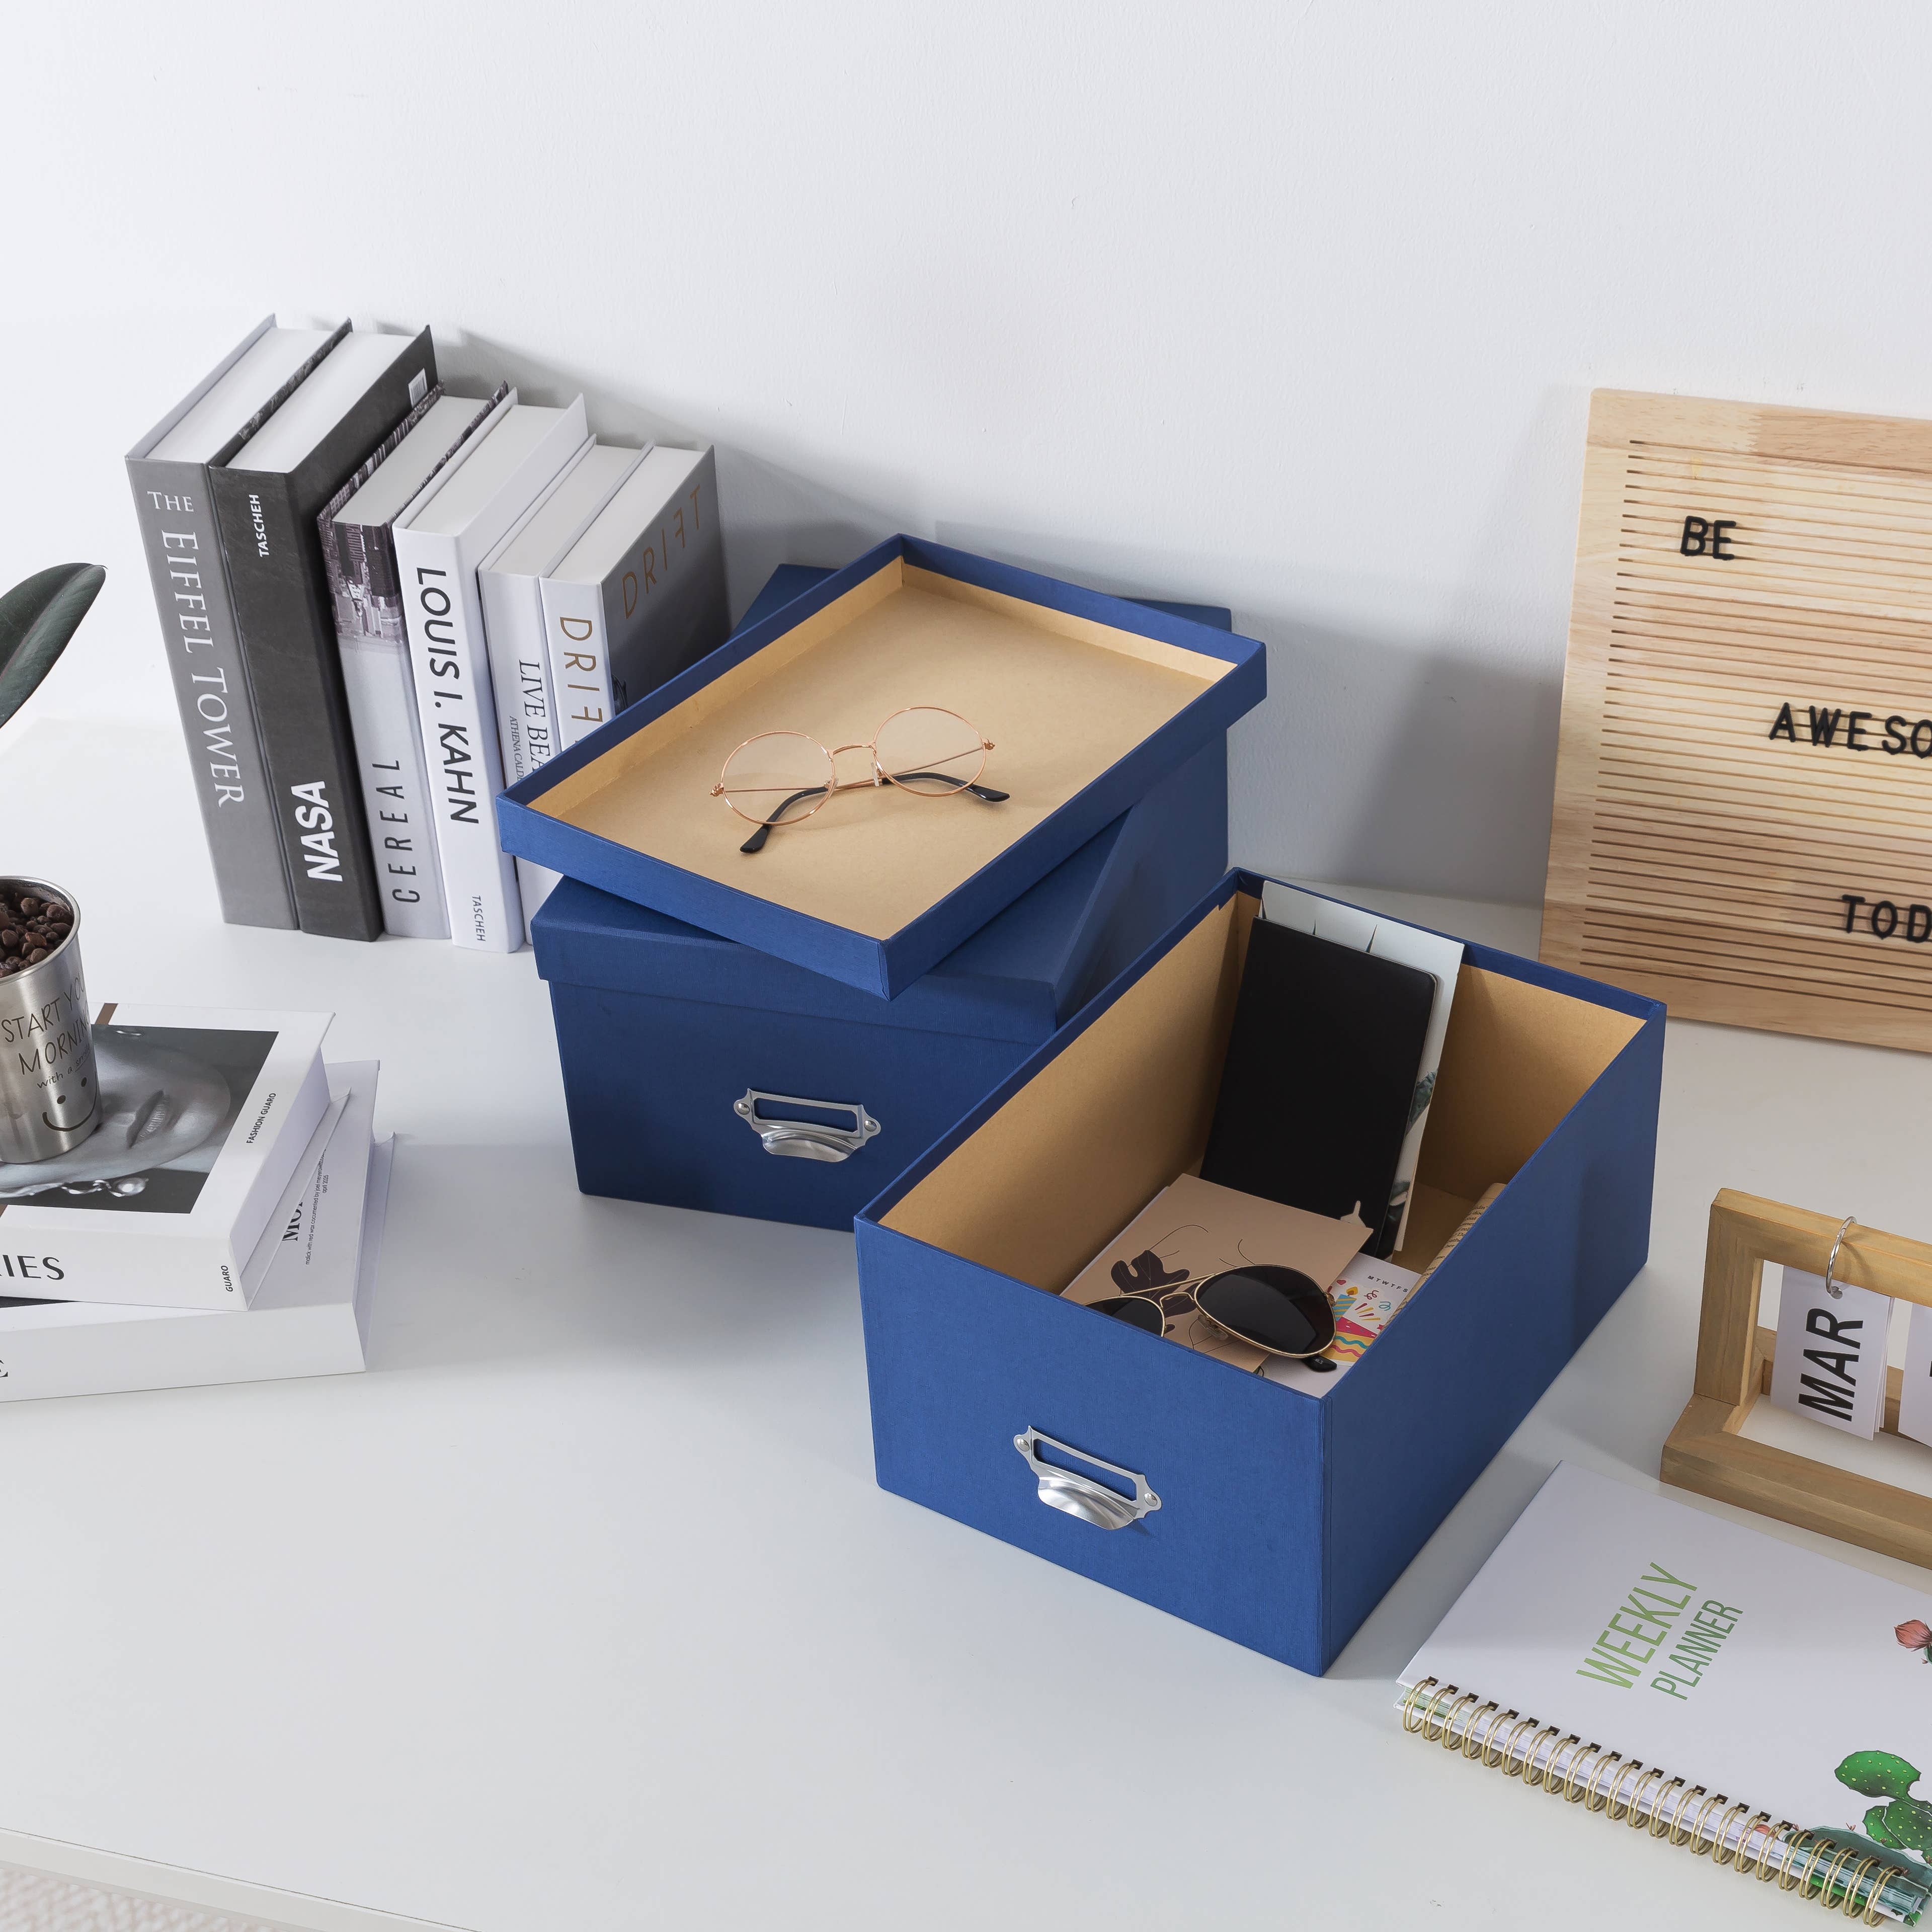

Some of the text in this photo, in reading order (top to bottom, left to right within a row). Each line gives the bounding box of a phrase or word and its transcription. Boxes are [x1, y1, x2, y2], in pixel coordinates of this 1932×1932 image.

[1680, 515, 1736, 560] BE
[147, 490, 245, 808] THE EIFFEL TOWER
[416, 567, 479, 824] LOUIS I. KAHN
[519, 659, 546, 717] LIVE
[560, 616, 603, 744] DRIF
[510, 715, 519, 752] ATHENA
[1768, 702, 1932, 759] AWESO
[291, 780, 343, 881] NASA
[372, 760, 421, 903] CEREAL
[1841, 894, 1932, 942] TOD
[1, 997, 60, 1042] START
[37, 1072, 63, 1089] with
[68, 1066, 73, 1074] a
[246, 1092, 277, 1145] FASHION GUARO
[0, 1254, 64, 1281] IES
[221, 1265, 233, 1292] GUARO
[1798, 1308, 1863, 1422] MAR
[1575, 1562, 1698, 1689] WEEKLY
[1650, 1599, 1744, 1701] PLANNER
